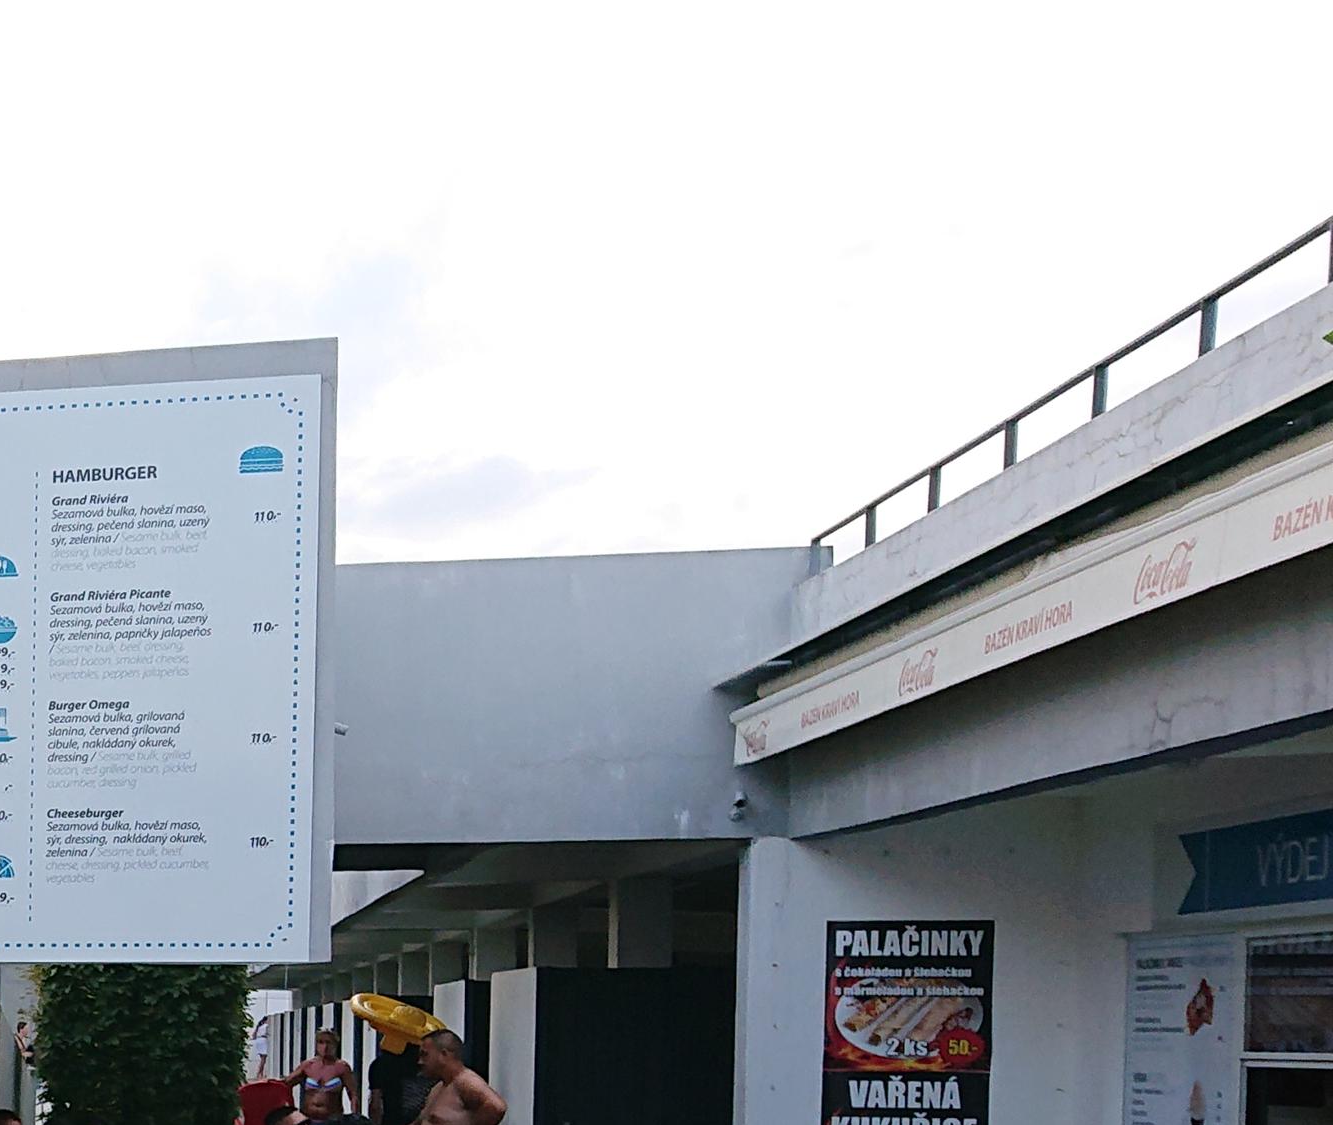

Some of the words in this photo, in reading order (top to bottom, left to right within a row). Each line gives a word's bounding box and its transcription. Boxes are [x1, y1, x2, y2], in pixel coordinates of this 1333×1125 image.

[53, 466, 157, 483] HAMBURGER
[52, 495, 86, 506] Grand
[90, 494, 128, 505] Riviéra
[52, 507, 103, 519] Sezamová
[106, 506, 137, 518] bulka,
[140, 504, 173, 516] hovězí
[176, 505, 206, 514] maso,
[49, 701, 86, 712] Burger
[89, 700, 129, 711] Omega
[47, 808, 124, 820] Cheeseburger
[835, 925, 984, 957] PALAČINKY
[887, 1038, 898, 1056] 2
[848, 1075, 961, 1109] VAŘENÁ
